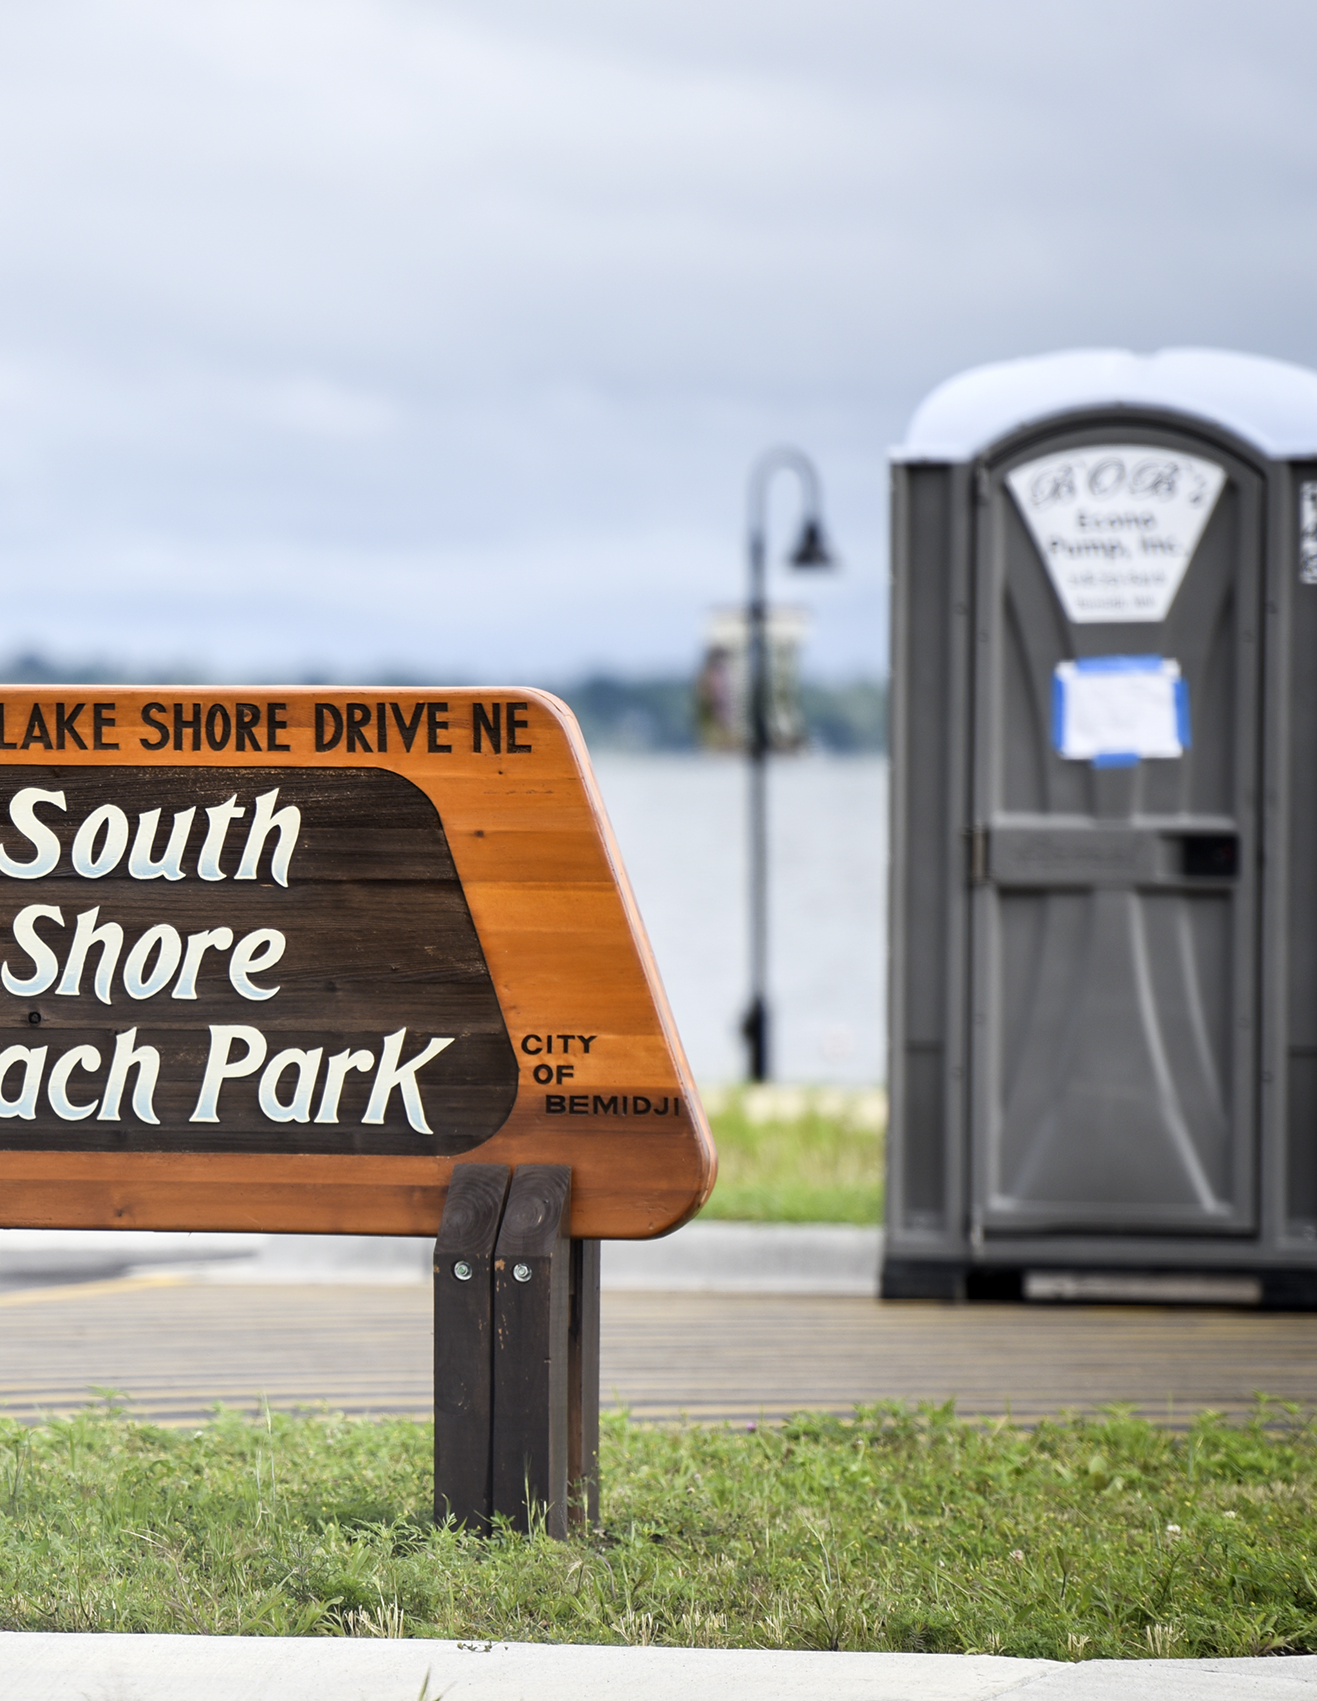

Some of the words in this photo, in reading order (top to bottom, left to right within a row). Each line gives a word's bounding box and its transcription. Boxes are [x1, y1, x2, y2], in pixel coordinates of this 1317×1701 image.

[139, 702, 290, 752] SHORE
[315, 702, 453, 753] DRIVE
[473, 701, 533, 754] NE
[1, 904, 286, 1005] Shore
[521, 1034, 598, 1055] CITY
[533, 1064, 574, 1085] OF
[545, 1094, 680, 1116] BEMIDJI
